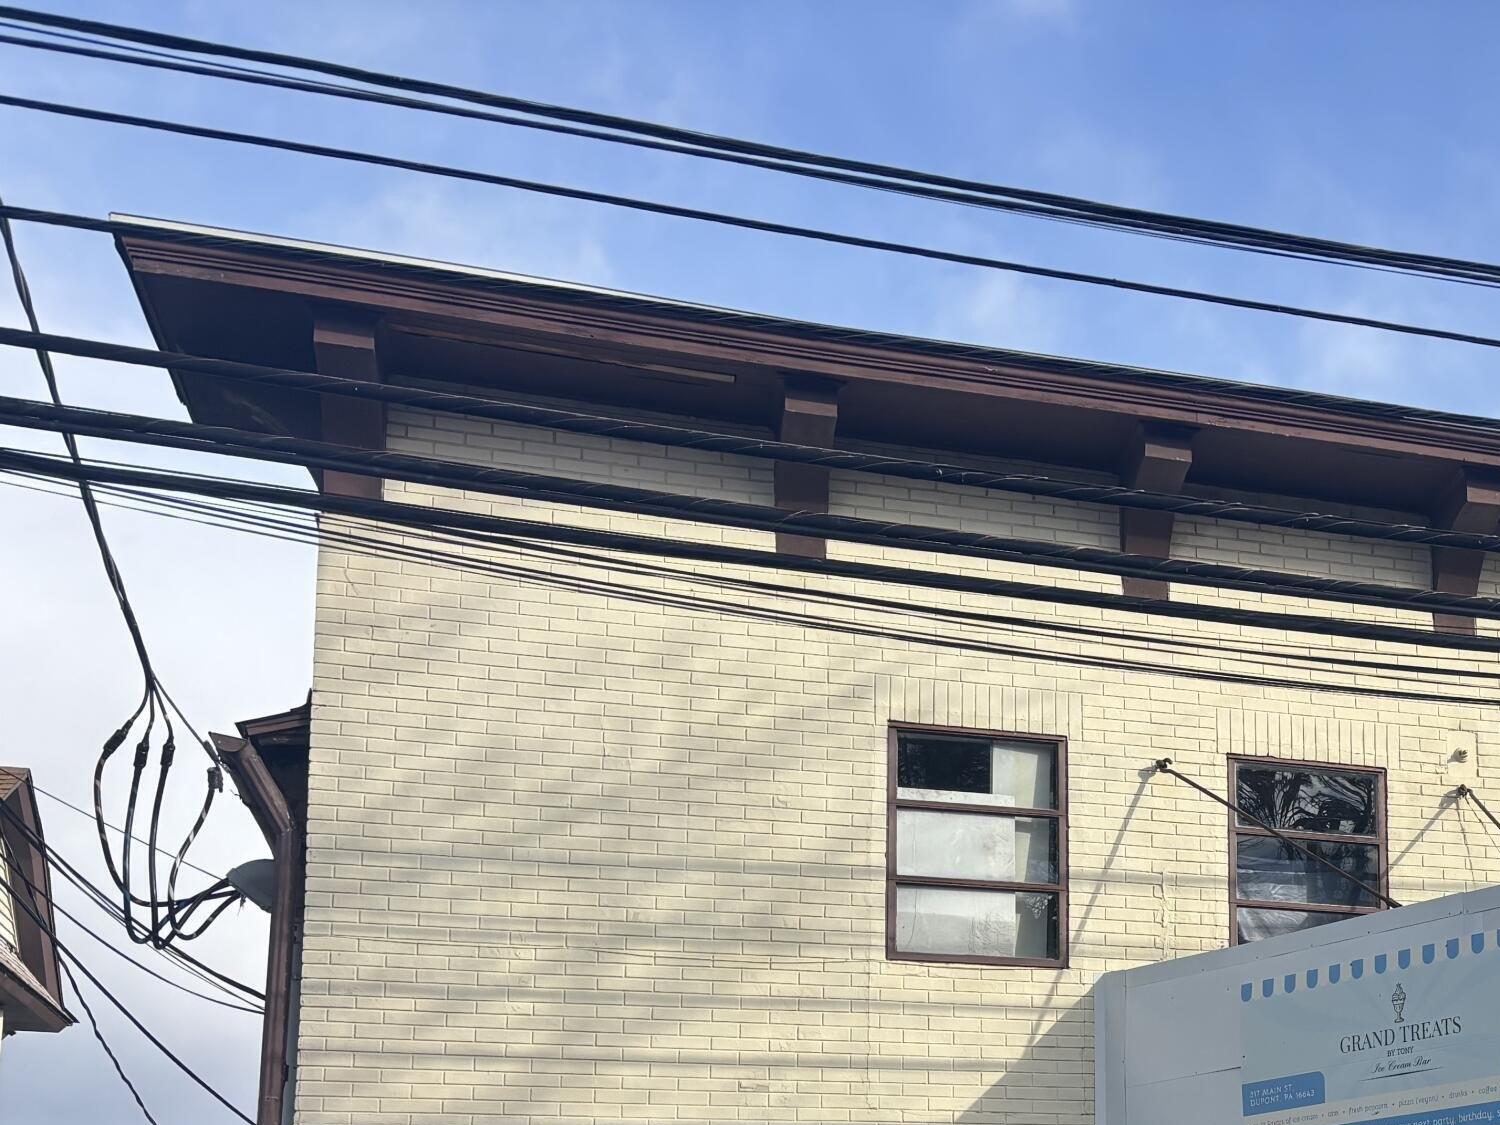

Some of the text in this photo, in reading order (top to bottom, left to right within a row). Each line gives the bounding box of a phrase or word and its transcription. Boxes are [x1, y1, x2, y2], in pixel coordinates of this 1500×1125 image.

[1340, 1015, 1462, 1054] GRAND TREATS
[1387, 1046, 1414, 1057] BY TONY
[1371, 1055, 1432, 1074] Ice Cream Bar
[1262, 1085, 1282, 1096] MAIN
[1449, 1089, 1468, 1099] drinks
[1478, 1085, 1498, 1095] coffee
